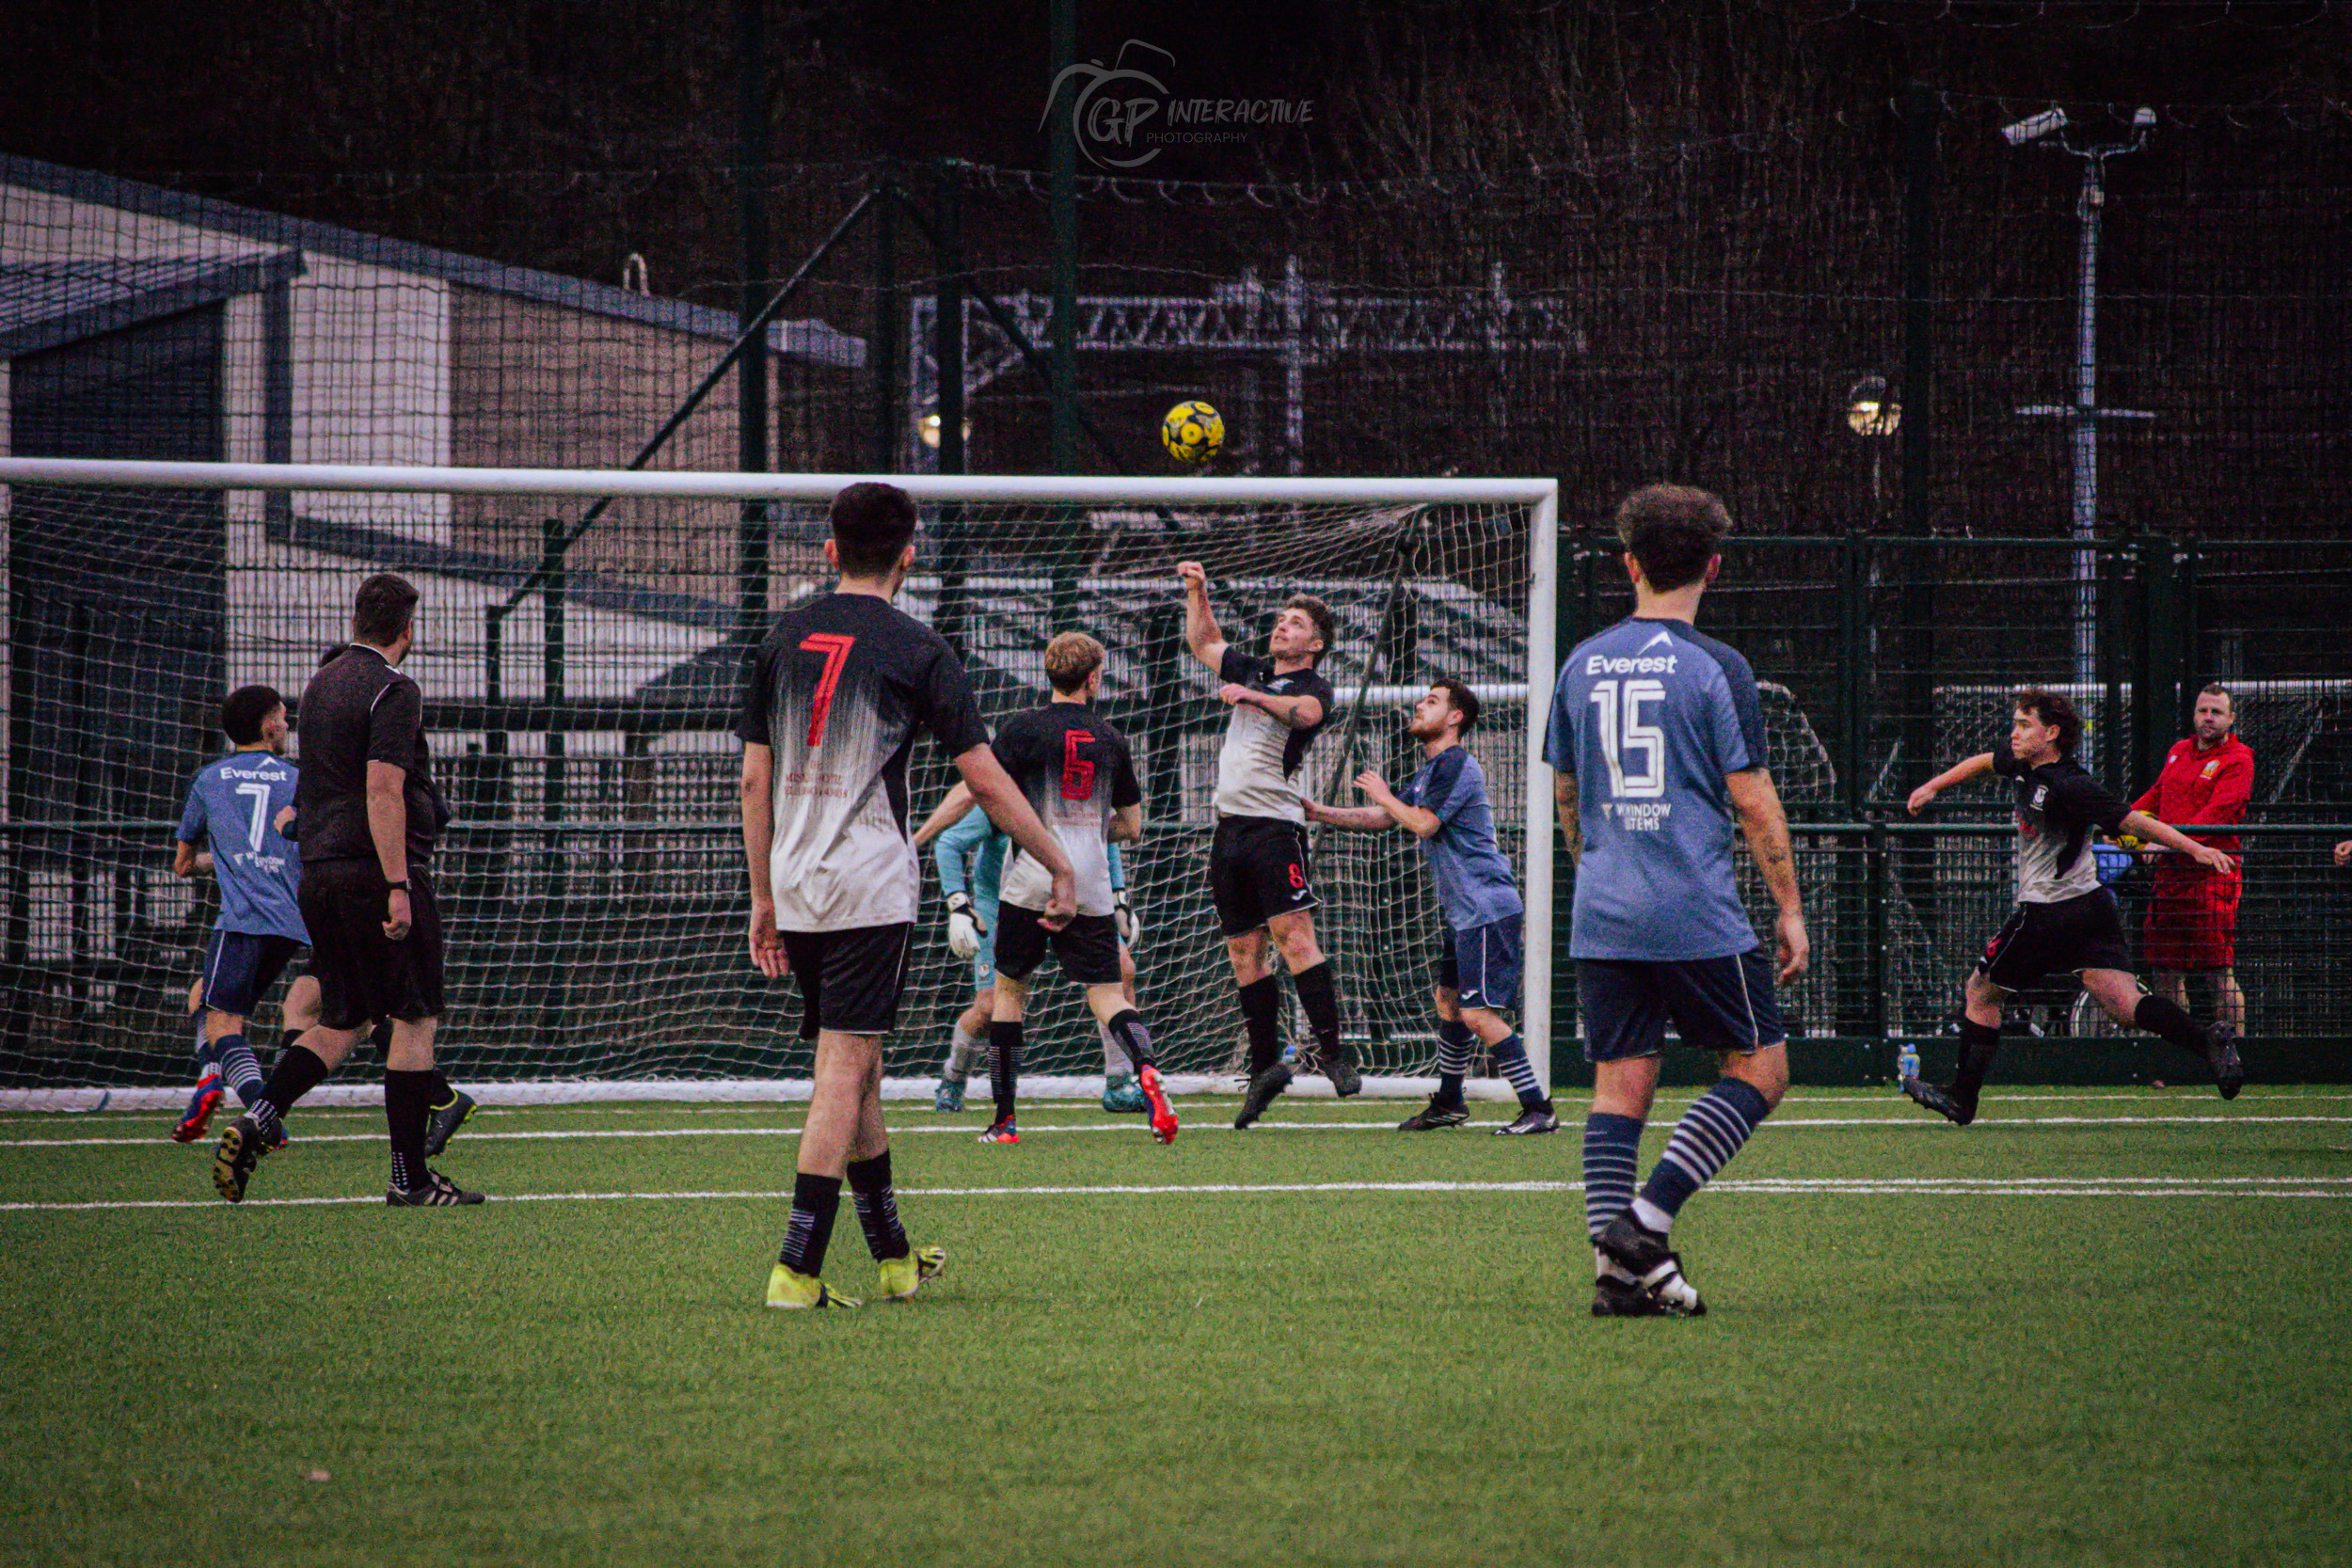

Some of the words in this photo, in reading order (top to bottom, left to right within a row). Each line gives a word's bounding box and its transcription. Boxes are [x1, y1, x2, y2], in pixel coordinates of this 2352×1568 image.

[800, 632, 856, 748] 7
[1586, 655, 1678, 675] Everest
[219, 766, 288, 782] Everest
[1061, 729, 1096, 800] 6
[1590, 679, 1666, 799] 15
[235, 782, 271, 852] 7
[1288, 863, 1304, 889] 8
